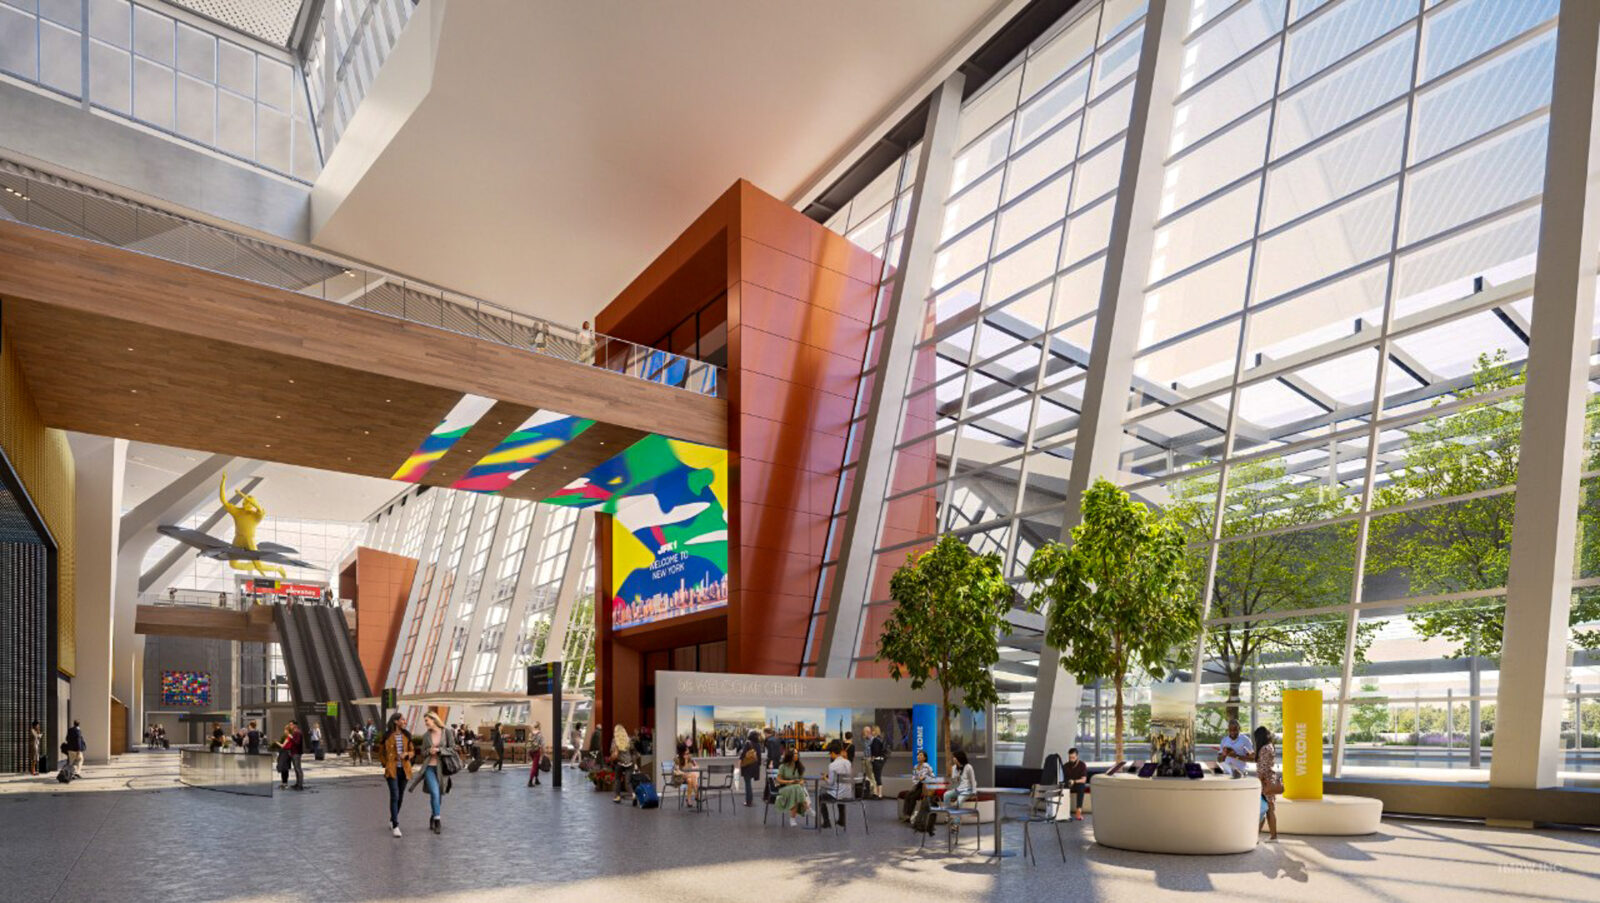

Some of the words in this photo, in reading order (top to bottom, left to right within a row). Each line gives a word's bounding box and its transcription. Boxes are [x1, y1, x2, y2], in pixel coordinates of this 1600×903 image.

[650, 553, 678, 571] WELCOME
[680, 550, 688, 560] TO
[652, 568, 667, 580] NEW
[668, 562, 684, 575] YORK
[1296, 722, 1307, 776] WELCOME
